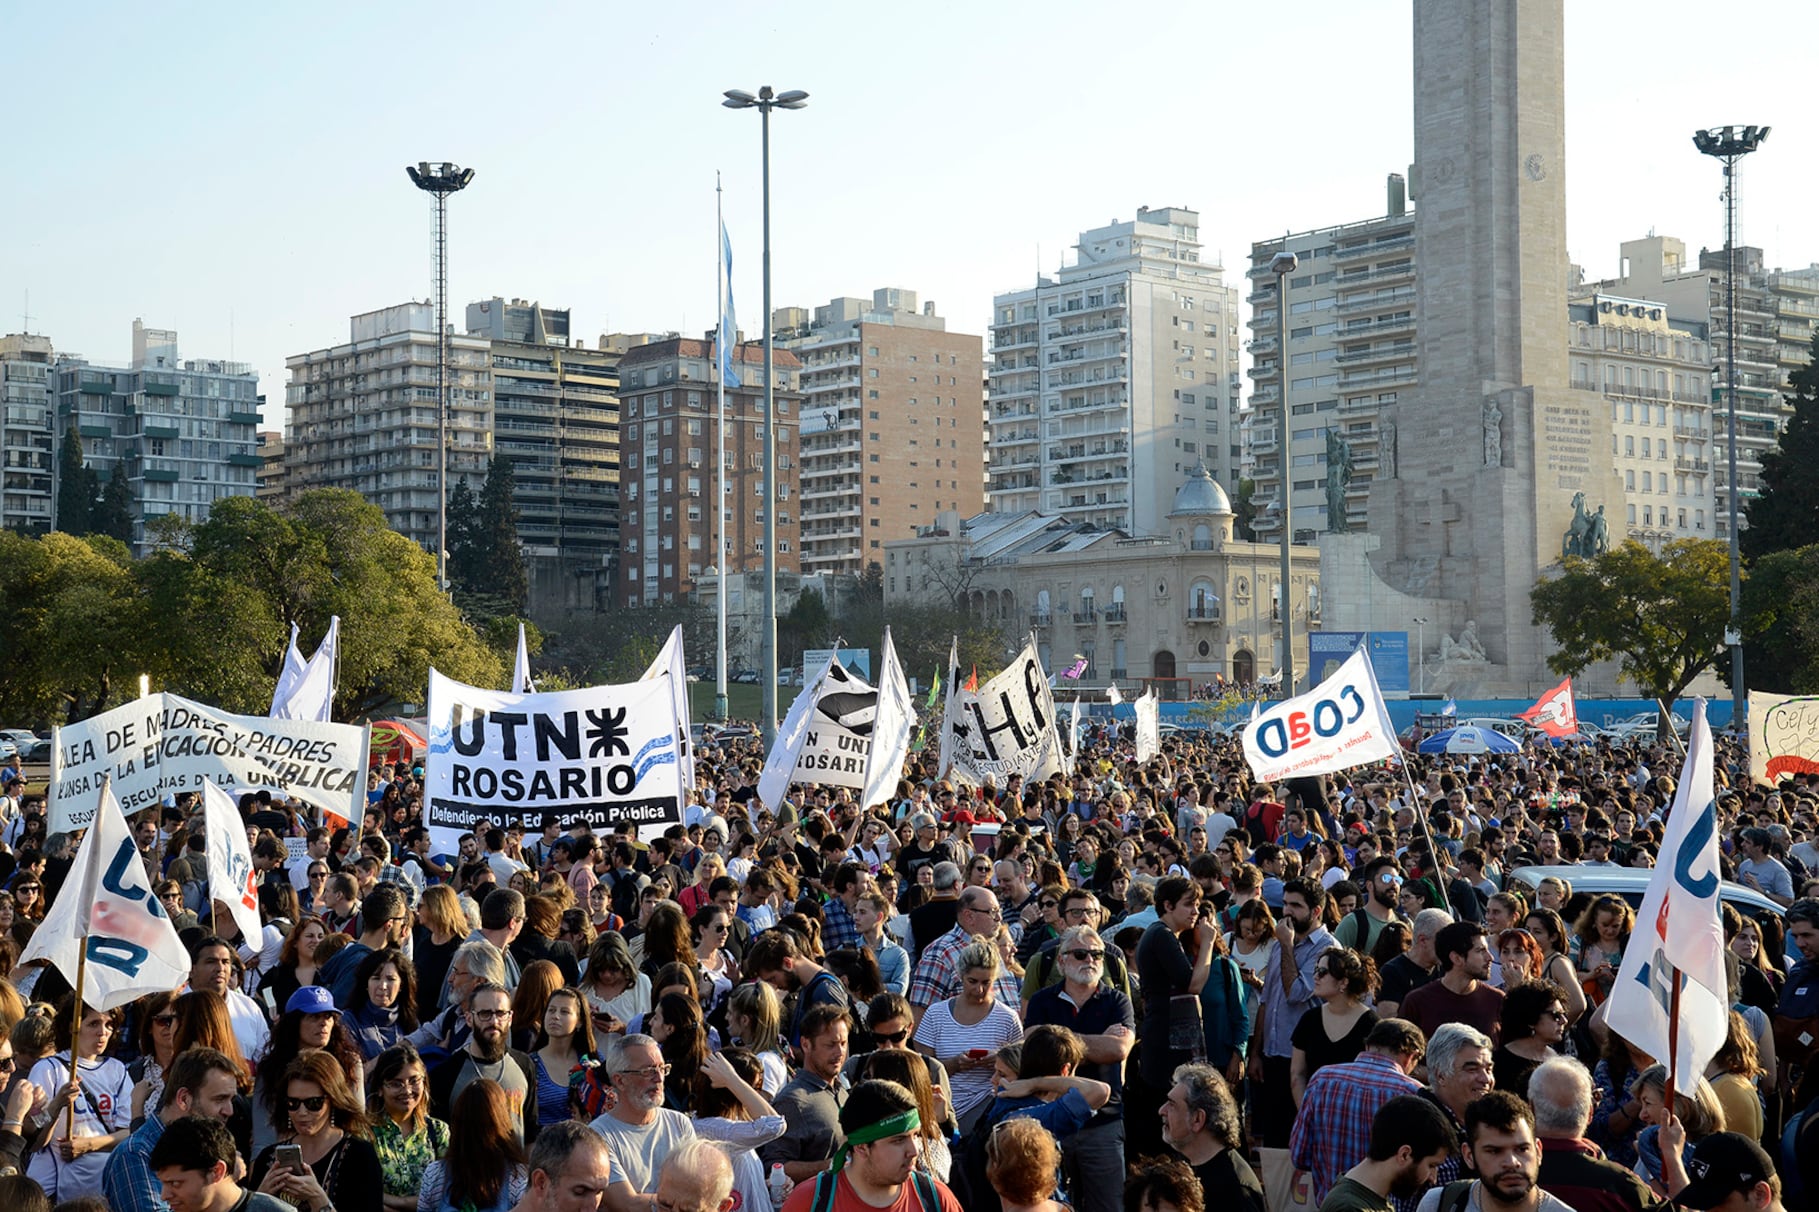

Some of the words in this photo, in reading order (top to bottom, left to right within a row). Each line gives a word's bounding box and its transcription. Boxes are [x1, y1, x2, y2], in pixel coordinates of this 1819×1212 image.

[106, 723, 136, 754] DE
[147, 708, 228, 738] MADRES
[246, 731, 337, 764] PADRES
[452, 704, 580, 762] UTN
[806, 731, 818, 747] N
[117, 760, 135, 780] LA
[797, 754, 865, 774] OSARI
[978, 743, 1042, 773] ESTUDIANTE
[68, 808, 98, 825] ESCUE
[217, 774, 235, 785] LA
[247, 771, 289, 791] UNR
[452, 764, 636, 802] ROSARIO
[522, 809, 604, 828] Edación
[609, 804, 666, 822] Pública
